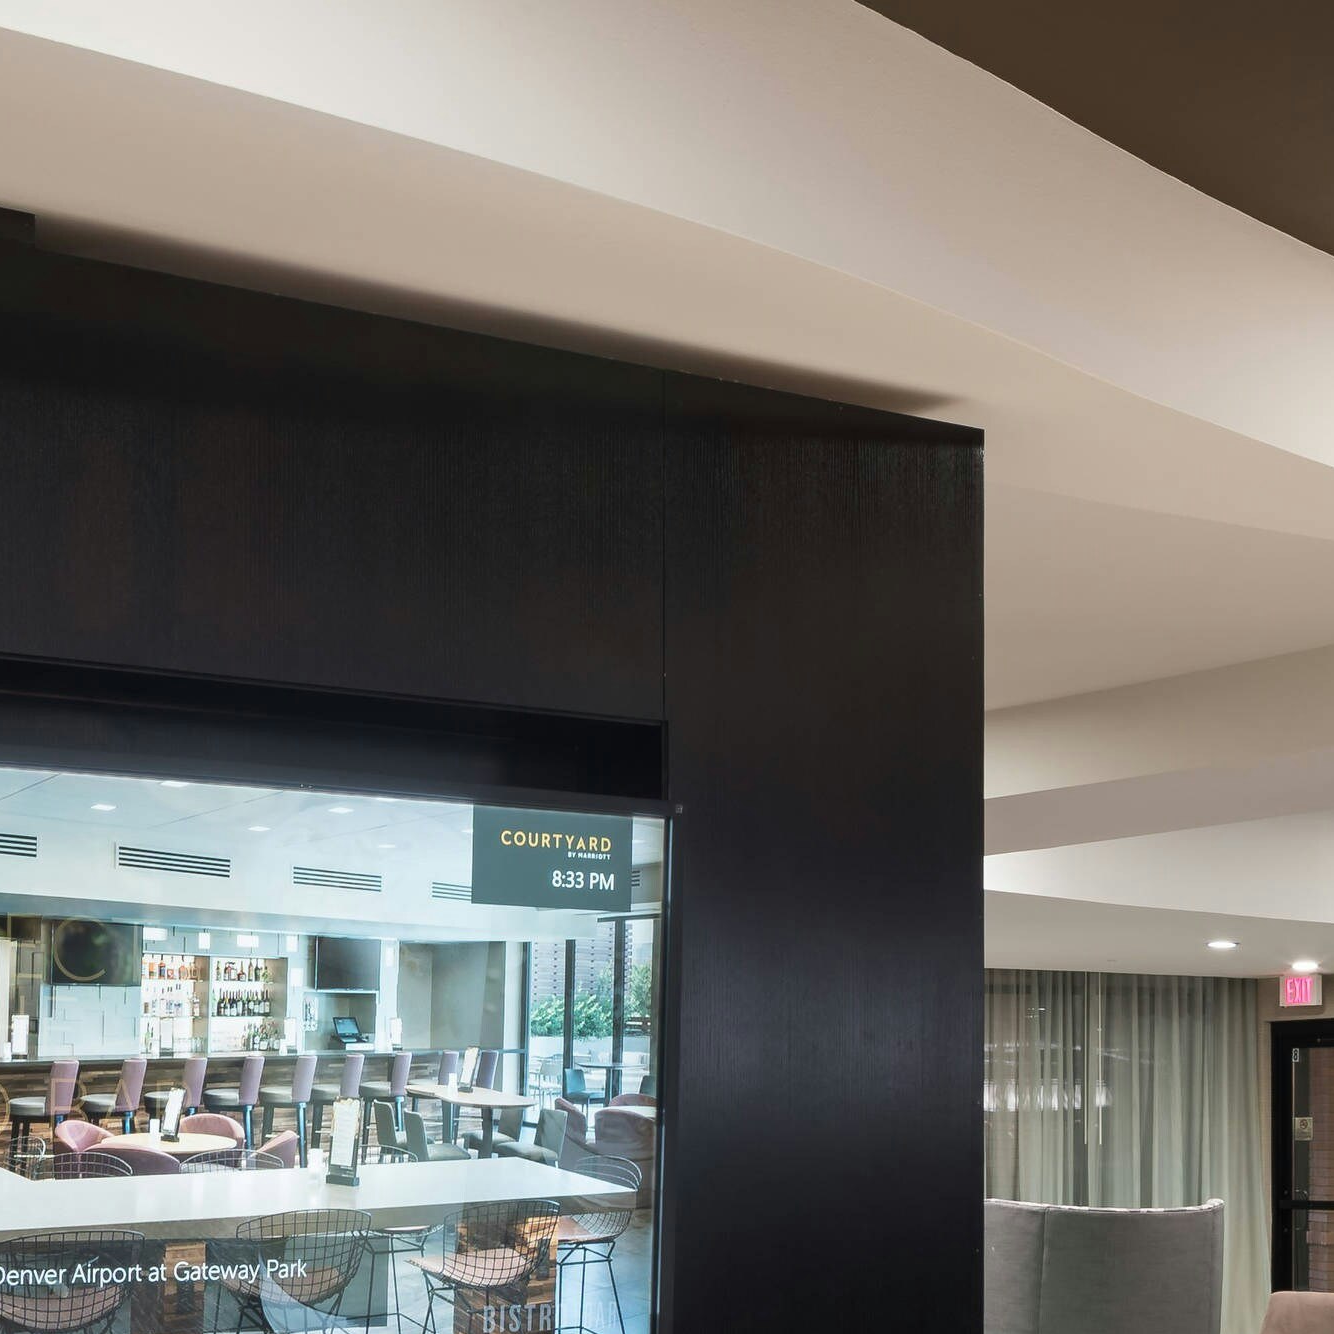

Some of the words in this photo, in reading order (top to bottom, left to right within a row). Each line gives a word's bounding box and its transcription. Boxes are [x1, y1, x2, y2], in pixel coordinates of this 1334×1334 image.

[500, 830, 612, 852] COURTYARD
[551, 869, 585, 889] 8:33
[589, 872, 615, 891] PM
[1285, 976, 1313, 1005] EXIT
[71, 1262, 143, 1287] Airport
[148, 1262, 167, 1282] at
[173, 1260, 261, 1284] Gateway
[267, 1257, 308, 1279] Park
[482, 1302, 556, 1334] BISTR
